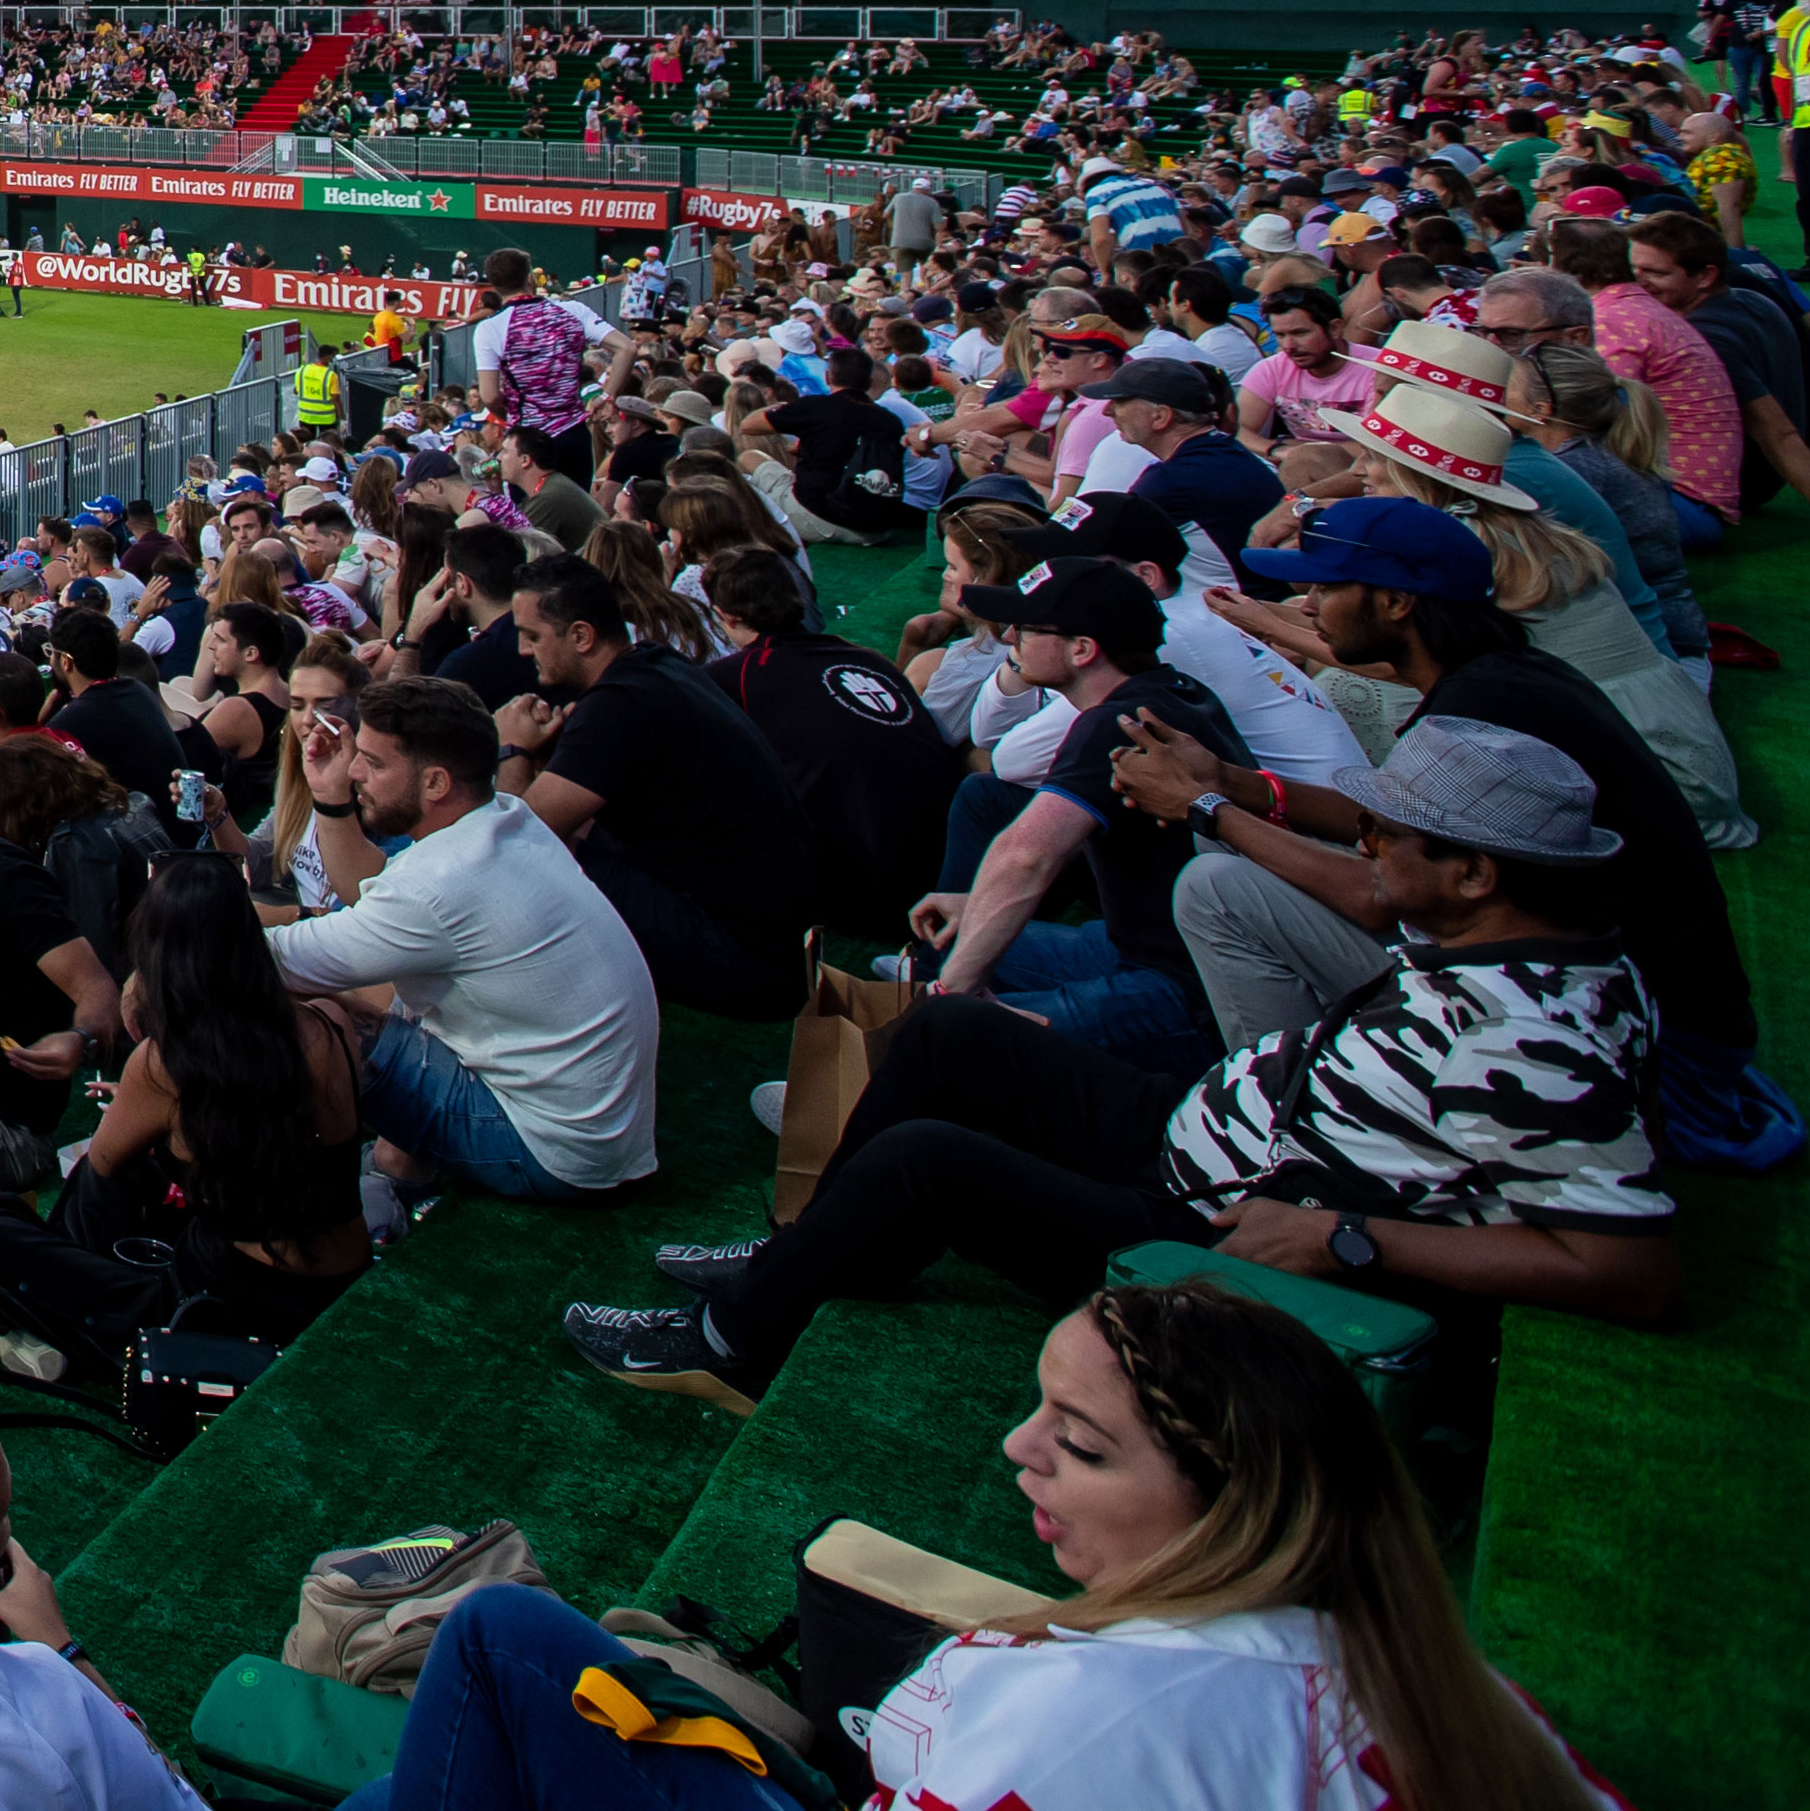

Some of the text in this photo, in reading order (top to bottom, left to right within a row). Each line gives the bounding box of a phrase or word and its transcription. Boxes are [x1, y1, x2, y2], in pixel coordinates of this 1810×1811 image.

[6, 169, 138, 191] Emirates FLY BETTER
[151, 176, 295, 200] Emirates FLY BETTER
[324, 187, 422, 208] Heineken
[483, 193, 656, 221] Emirates FLY BETTER
[437, 286, 477, 319] FLY
